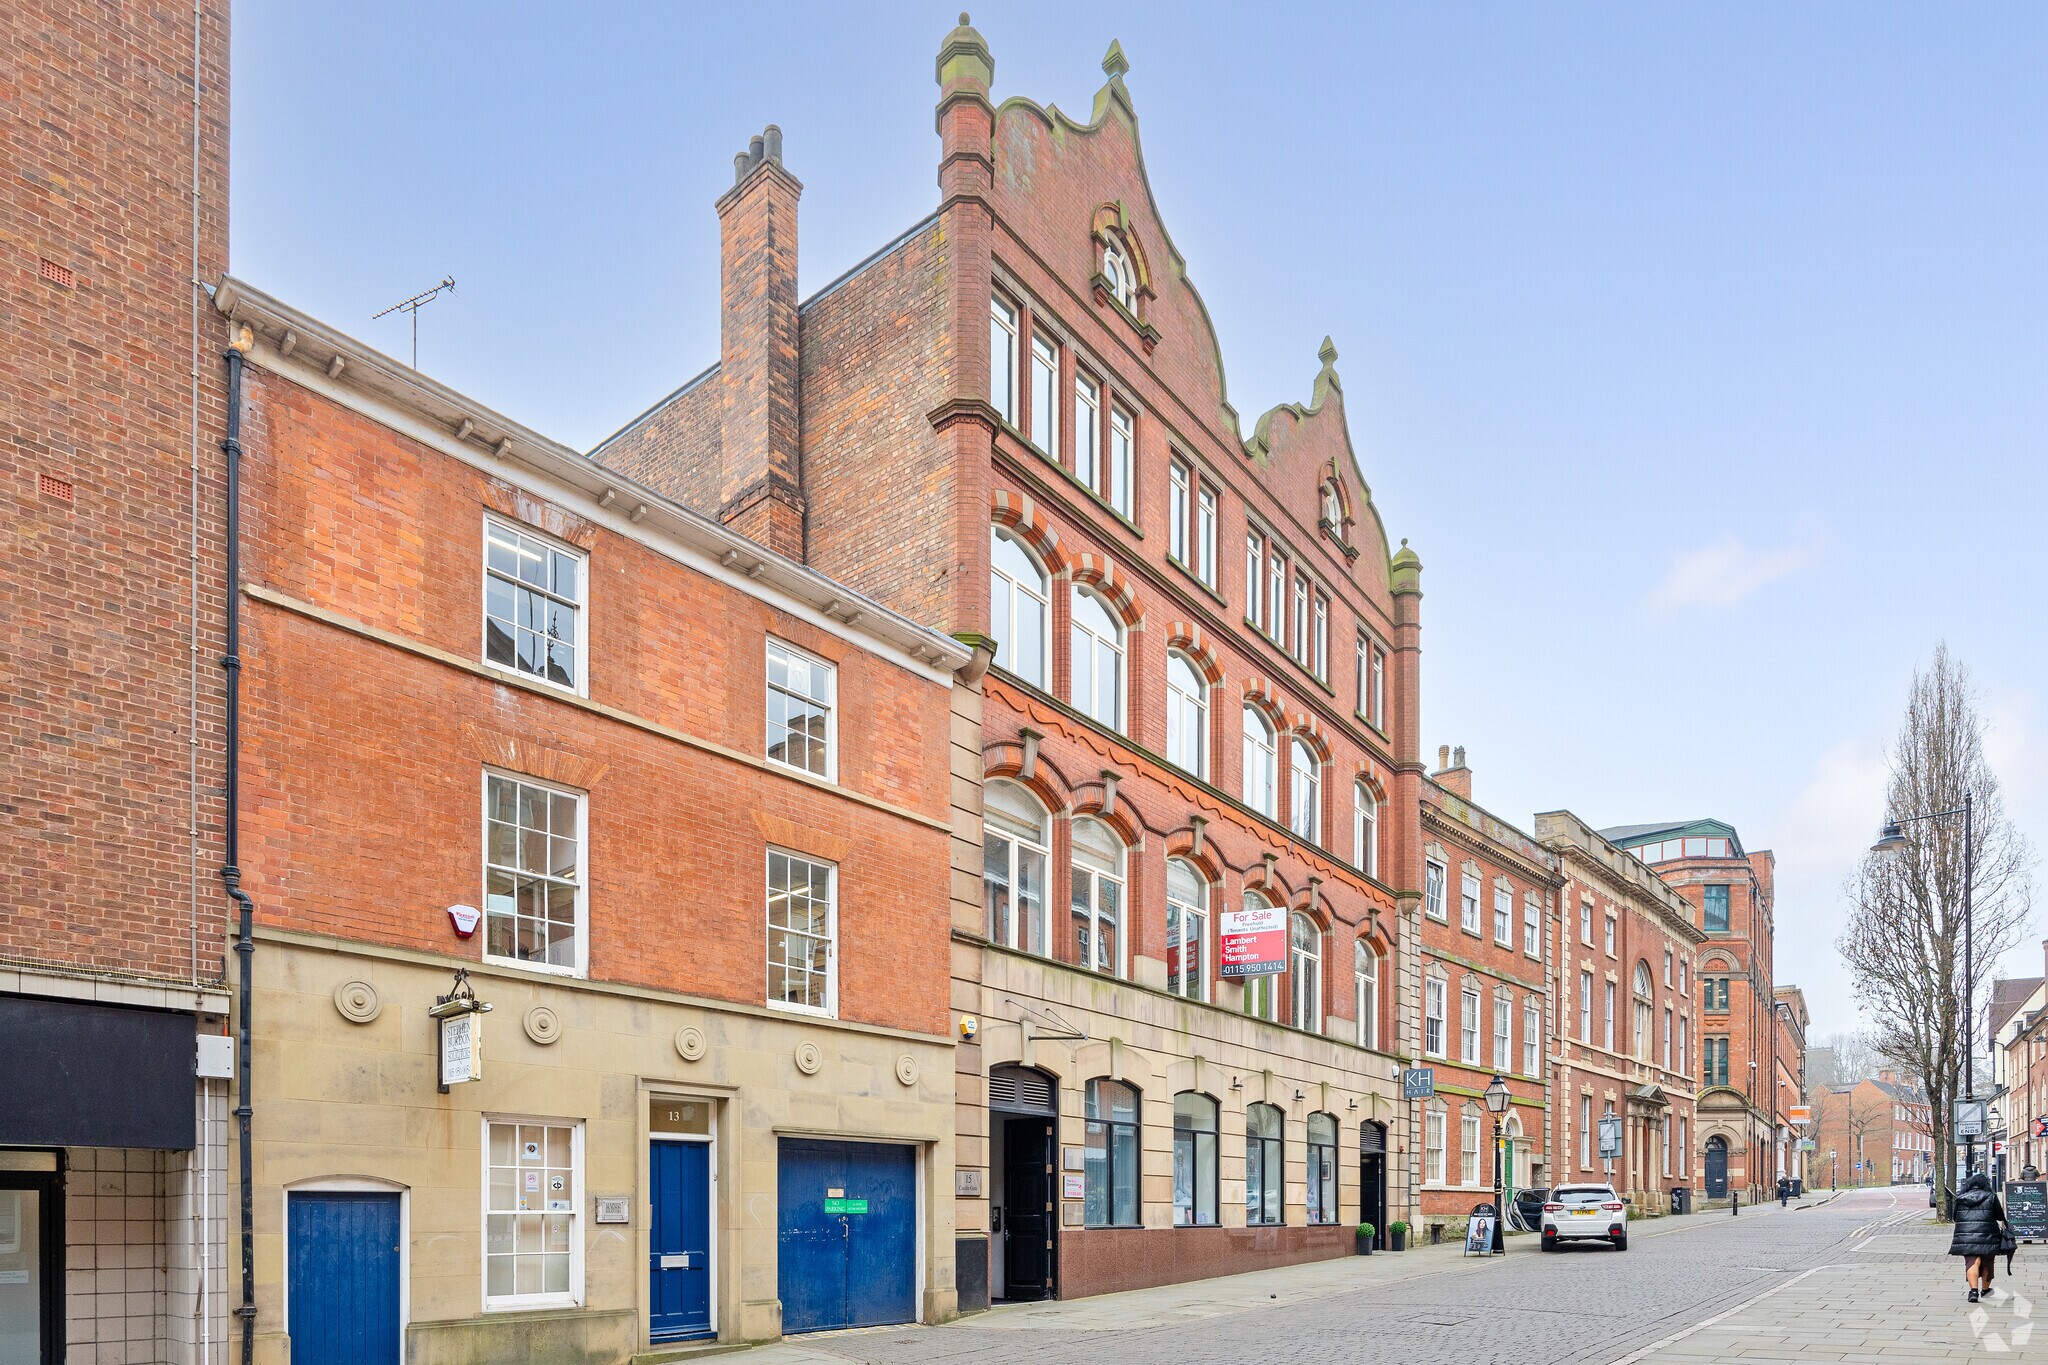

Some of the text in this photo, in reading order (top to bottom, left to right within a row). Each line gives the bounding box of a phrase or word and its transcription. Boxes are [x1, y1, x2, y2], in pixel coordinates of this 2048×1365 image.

[1233, 911, 1272, 922] For Sale
[1225, 936, 1257, 945] Lambert
[1225, 945, 1247, 953] Smith
[1225, 953, 1259, 962] Hampton
[1225, 962, 1282, 974] 0115 950 1414
[447, 1021, 470, 1037] STEPHEN
[1406, 1071, 1430, 1087] KH
[668, 1111, 680, 1122] 13
[965, 1174, 972, 1183] 15
